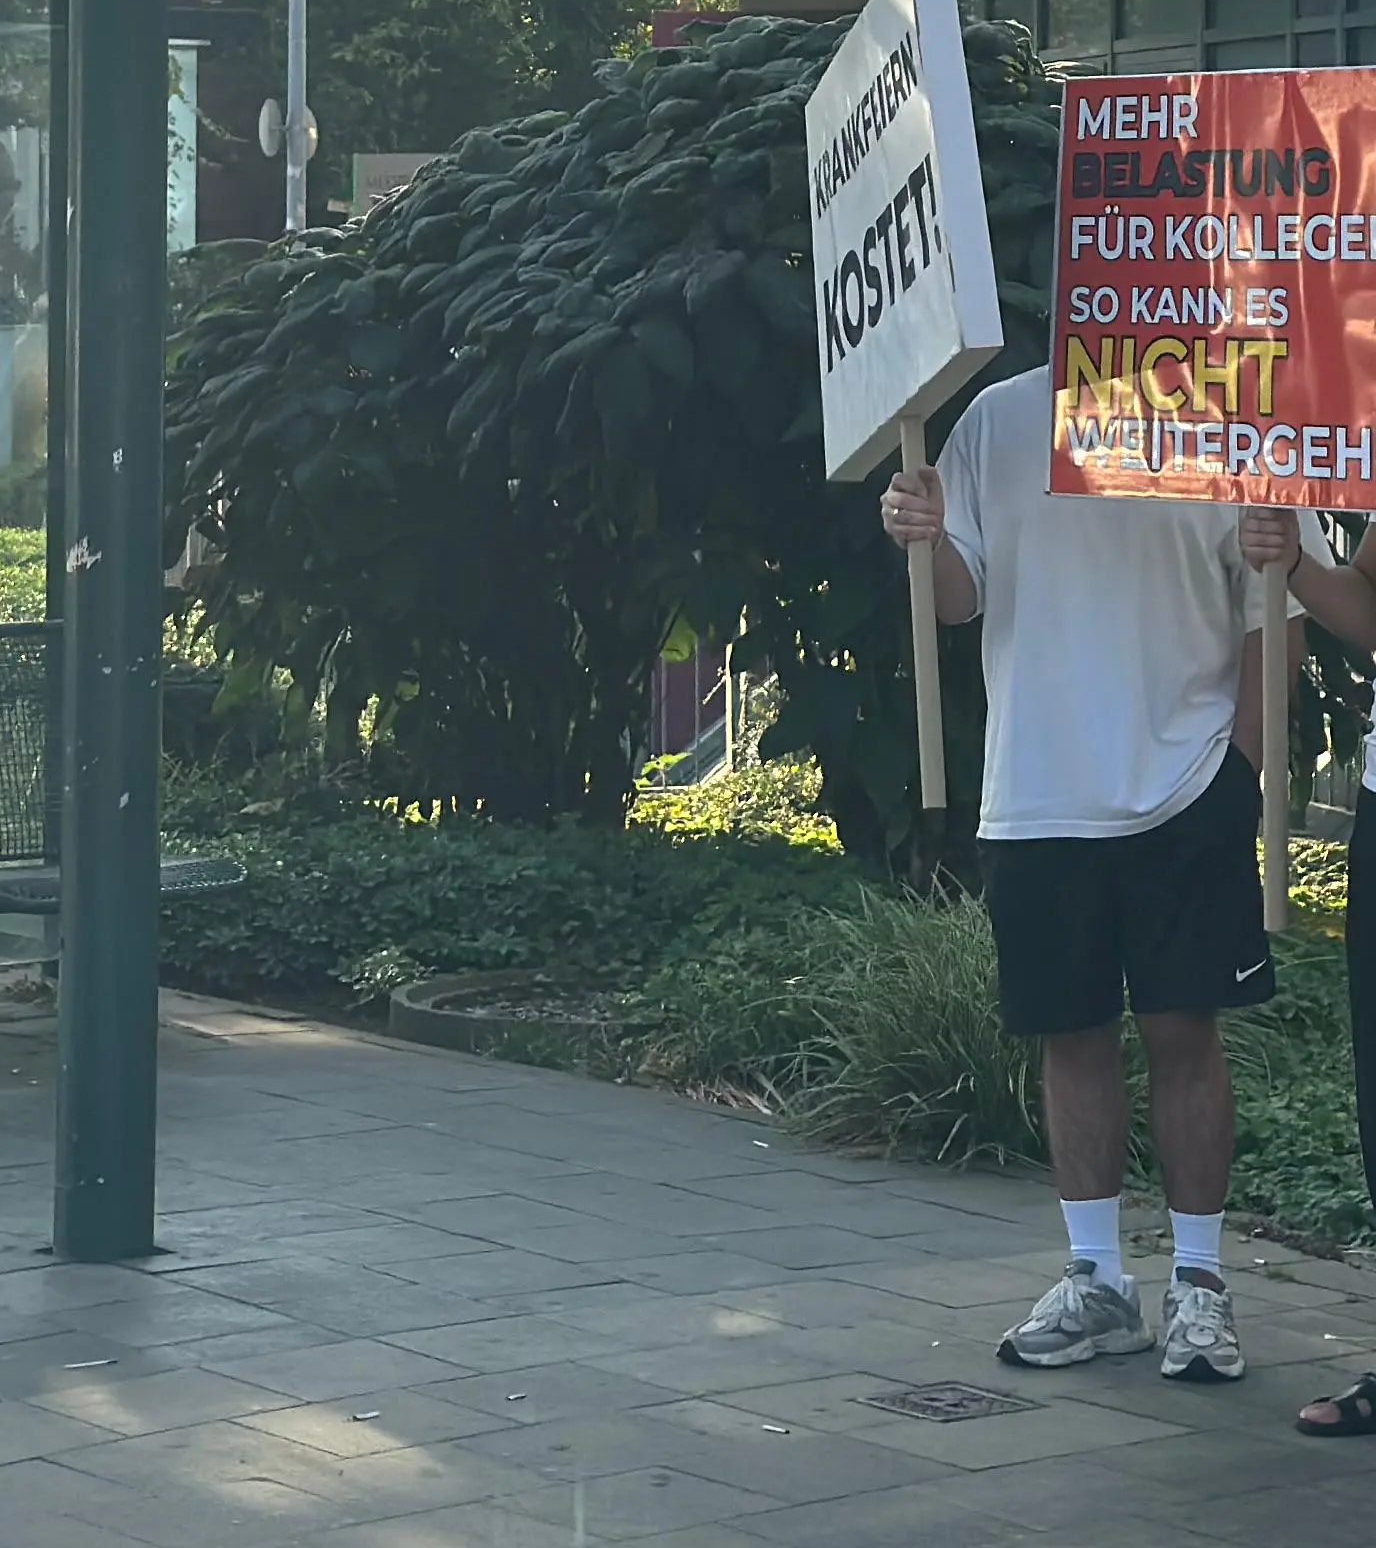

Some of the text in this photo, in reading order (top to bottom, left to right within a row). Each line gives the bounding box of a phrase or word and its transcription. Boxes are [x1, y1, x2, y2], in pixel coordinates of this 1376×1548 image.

[814, 30, 918, 219] KRANKFEIERN
[1076, 94, 1200, 141] MEHR
[1071, 147, 1332, 199] BELASTUNG
[1071, 204, 1156, 261] FÜR
[823, 152, 942, 374] KOSTET!
[1069, 286, 1290, 328] SO KANN ES
[1065, 334, 1289, 417] NICHT
